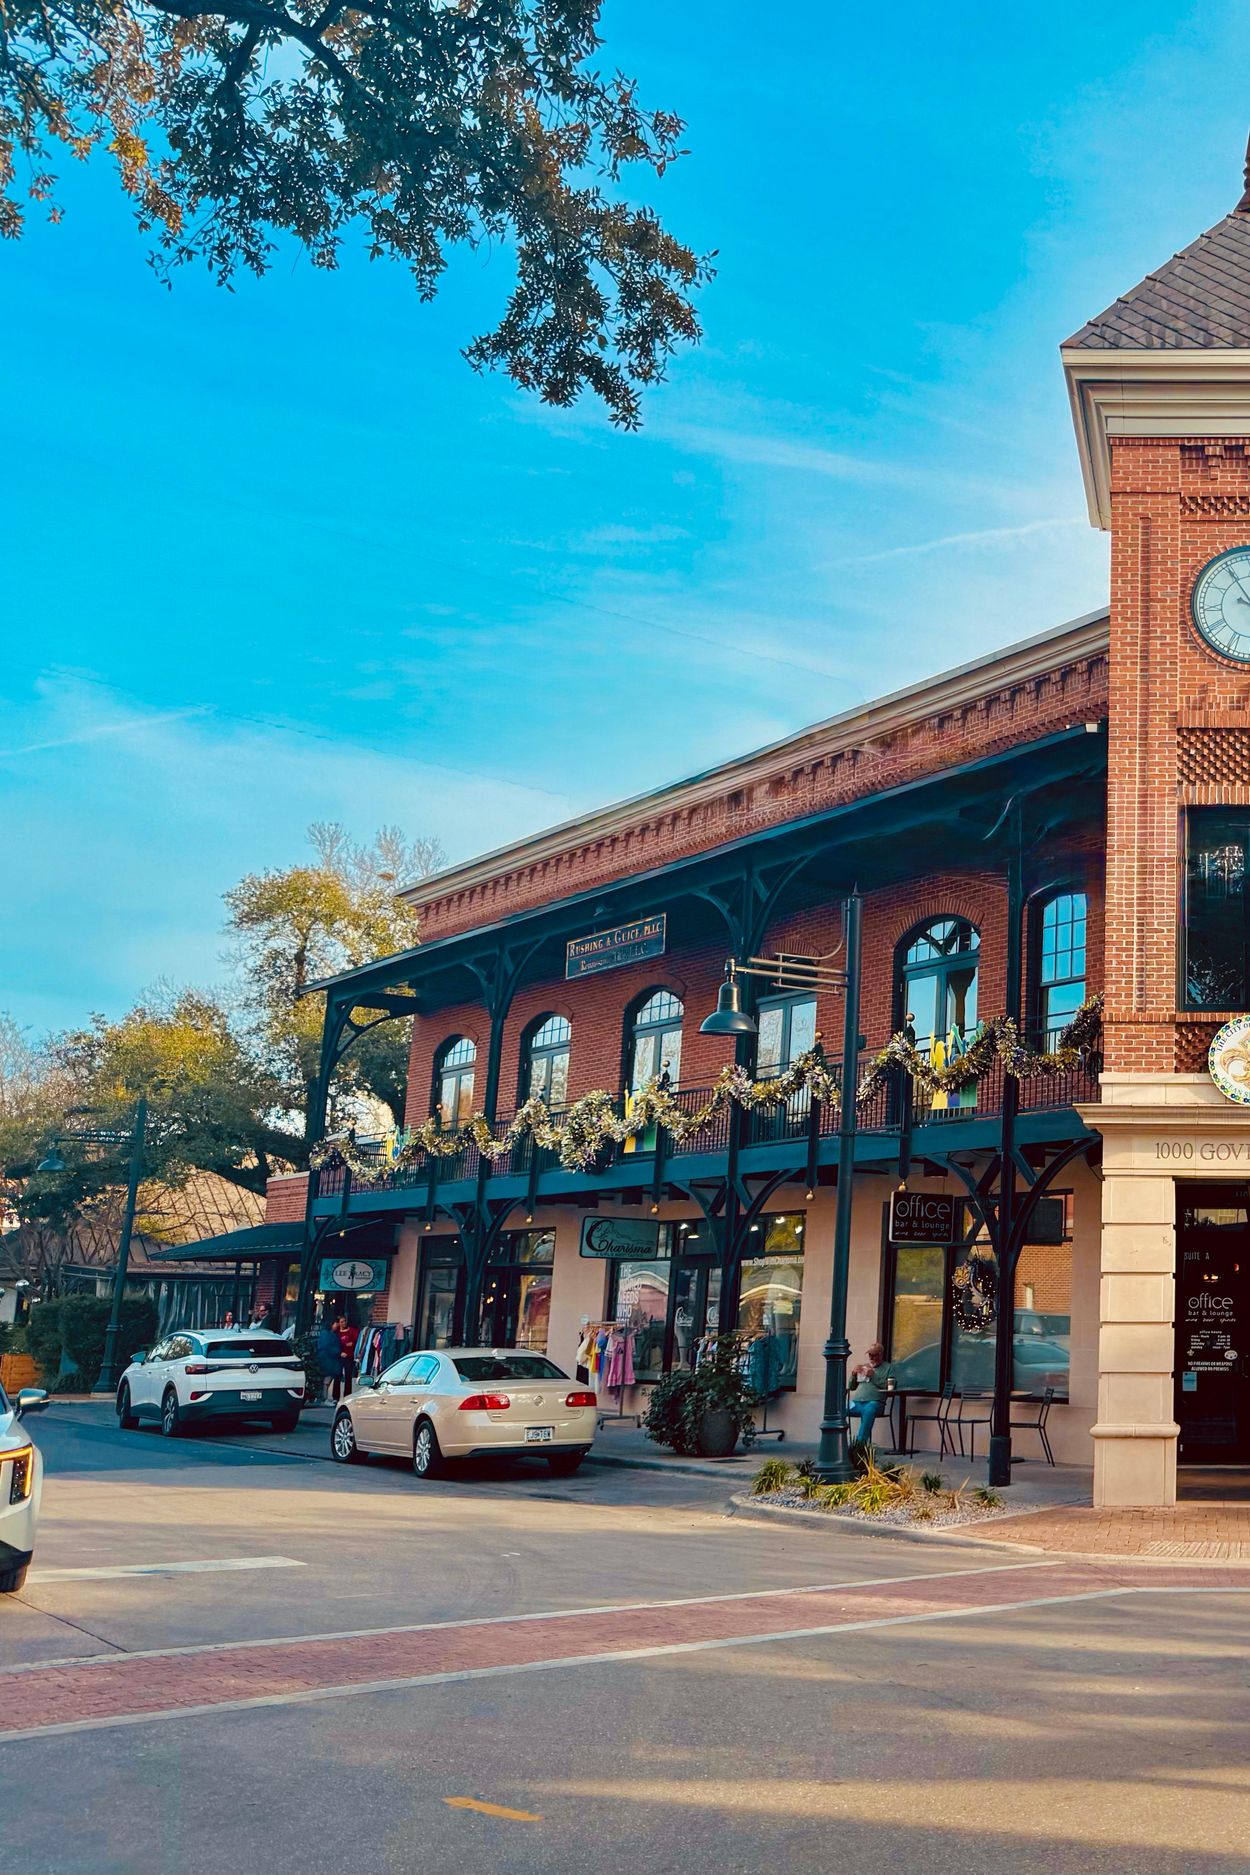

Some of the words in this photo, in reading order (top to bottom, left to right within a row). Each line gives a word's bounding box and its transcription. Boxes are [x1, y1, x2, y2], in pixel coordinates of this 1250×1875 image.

[570, 939, 603, 957] RUSHING
[1217, 1038, 1227, 1052] THE
[1226, 1024, 1242, 1038] CITY
[1222, 1077, 1243, 1095] OCEAN
[1155, 1142, 1194, 1159] 1000
[896, 1195, 950, 1220] office
[912, 1220, 918, 1228] &
[921, 1220, 950, 1231] lounge
[586, 1219, 653, 1254] Charisma
[1184, 1252, 1200, 1260] SUITE
[1205, 1252, 1210, 1260] A
[620, 1264, 632, 1278] THE
[618, 1291, 640, 1304] NEEDS
[1188, 1292, 1234, 1309] office
[617, 1305, 632, 1317] WHO
